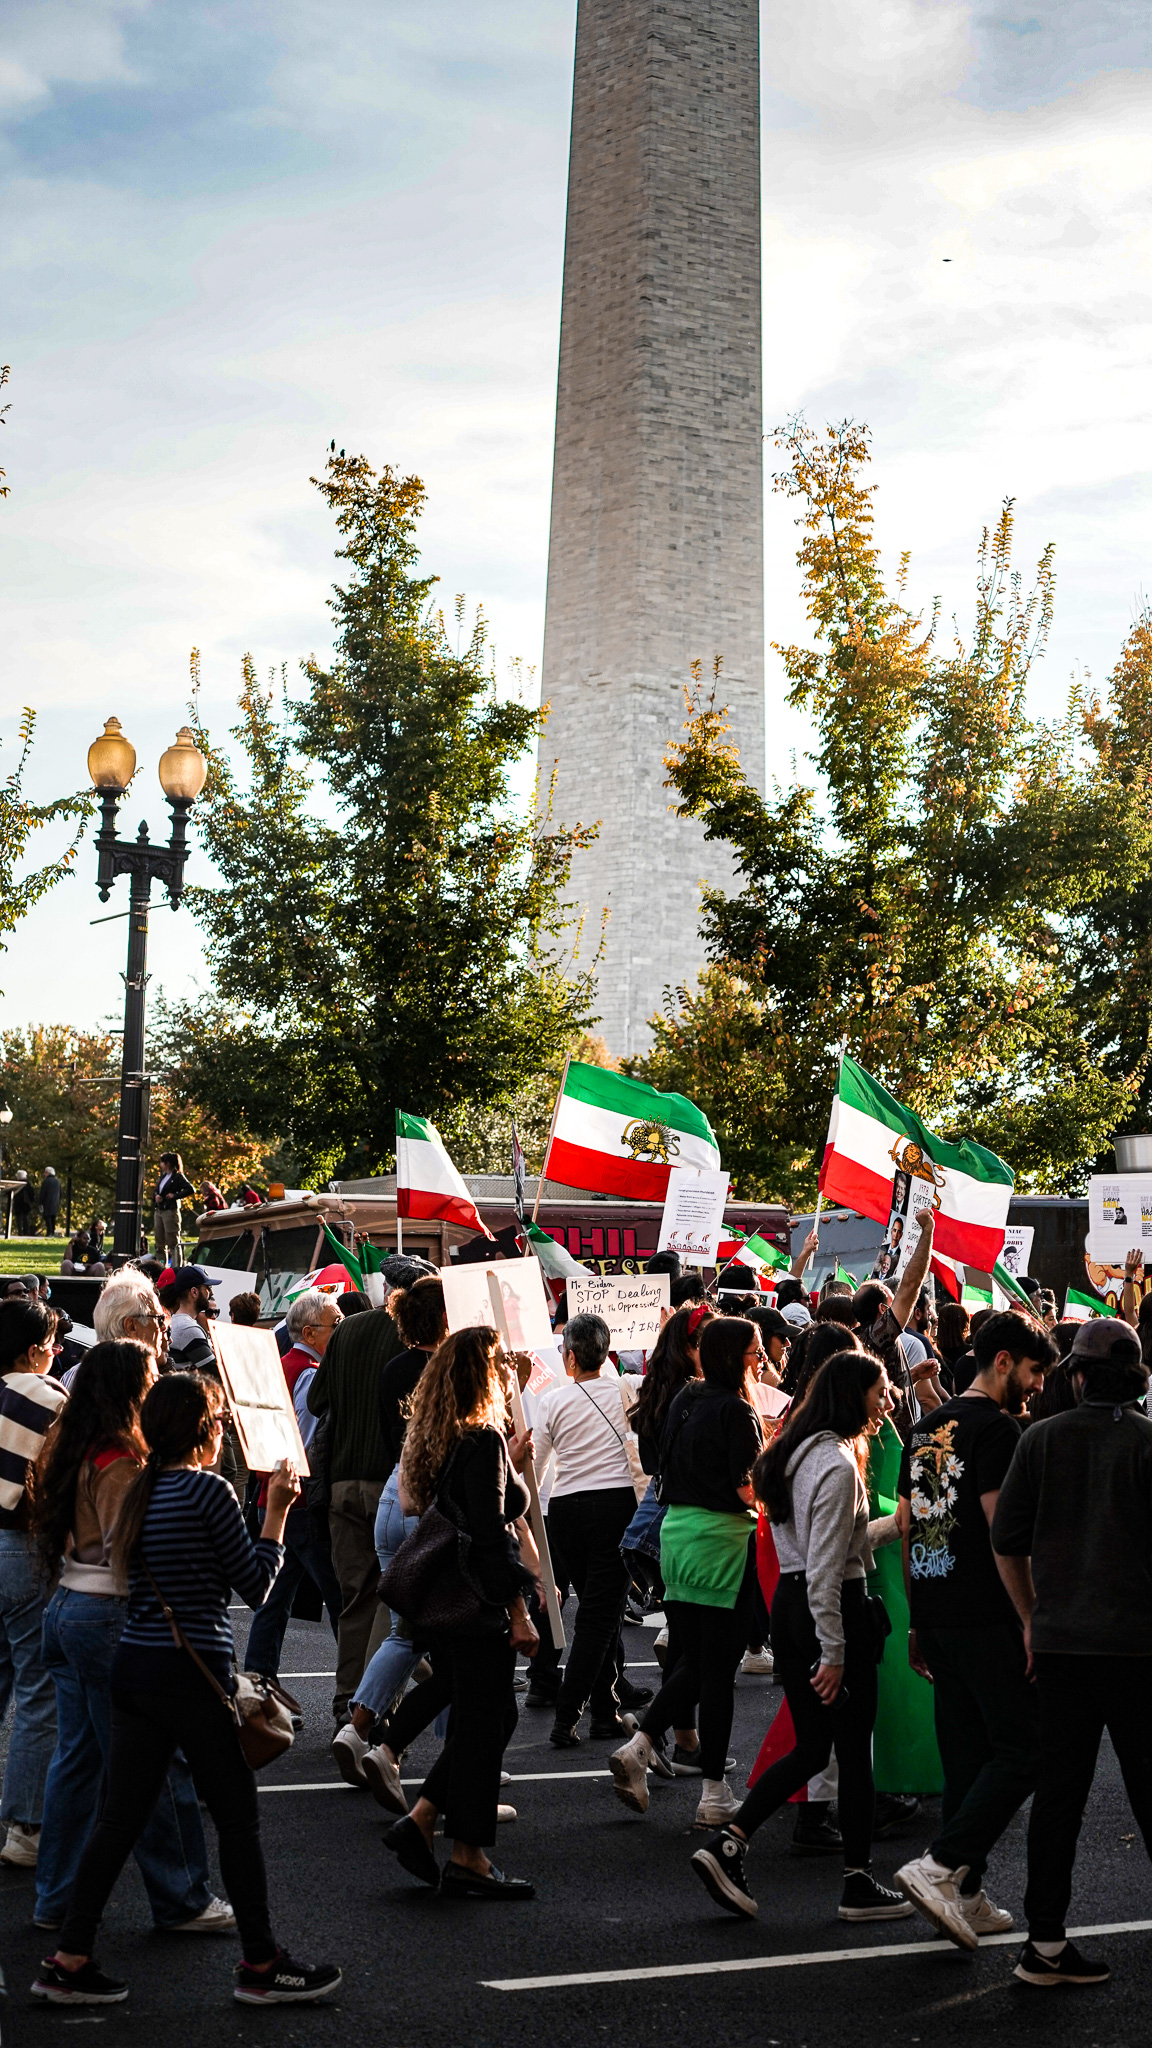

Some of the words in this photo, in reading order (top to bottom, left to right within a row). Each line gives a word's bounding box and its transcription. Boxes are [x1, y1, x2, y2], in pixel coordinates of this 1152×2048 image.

[588, 1279, 615, 1289] Biden
[576, 1289, 610, 1304] STOP
[617, 1283, 662, 1305] Dealing
[617, 1301, 659, 1312] Oppressive
[274, 1973, 306, 1986] HOKA
